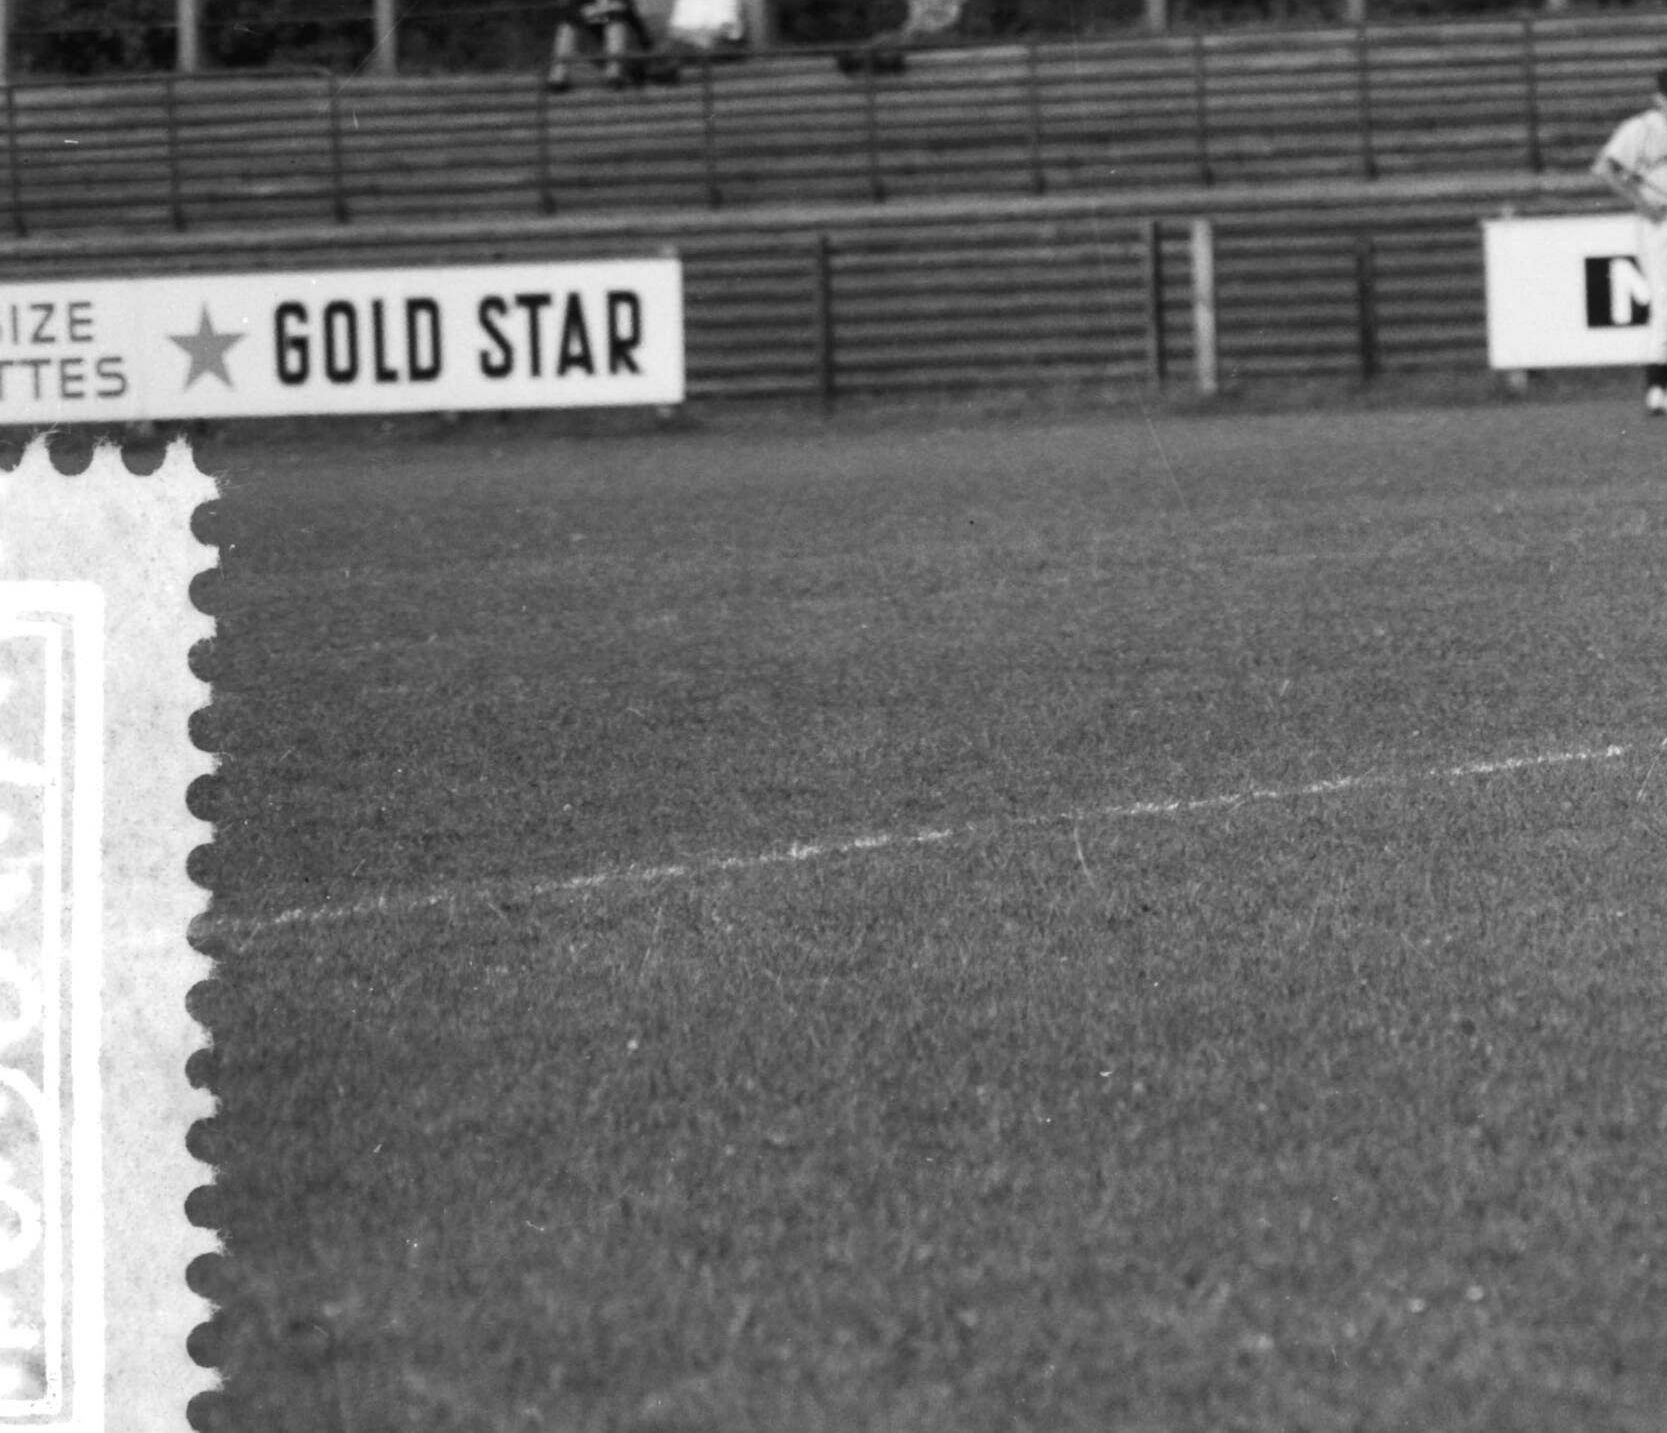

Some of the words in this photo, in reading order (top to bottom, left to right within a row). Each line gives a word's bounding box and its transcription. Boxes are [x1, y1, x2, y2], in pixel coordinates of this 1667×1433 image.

[0, 300, 95, 346] IZE
[274, 296, 443, 386] GOLD
[478, 289, 643, 380] STAR
